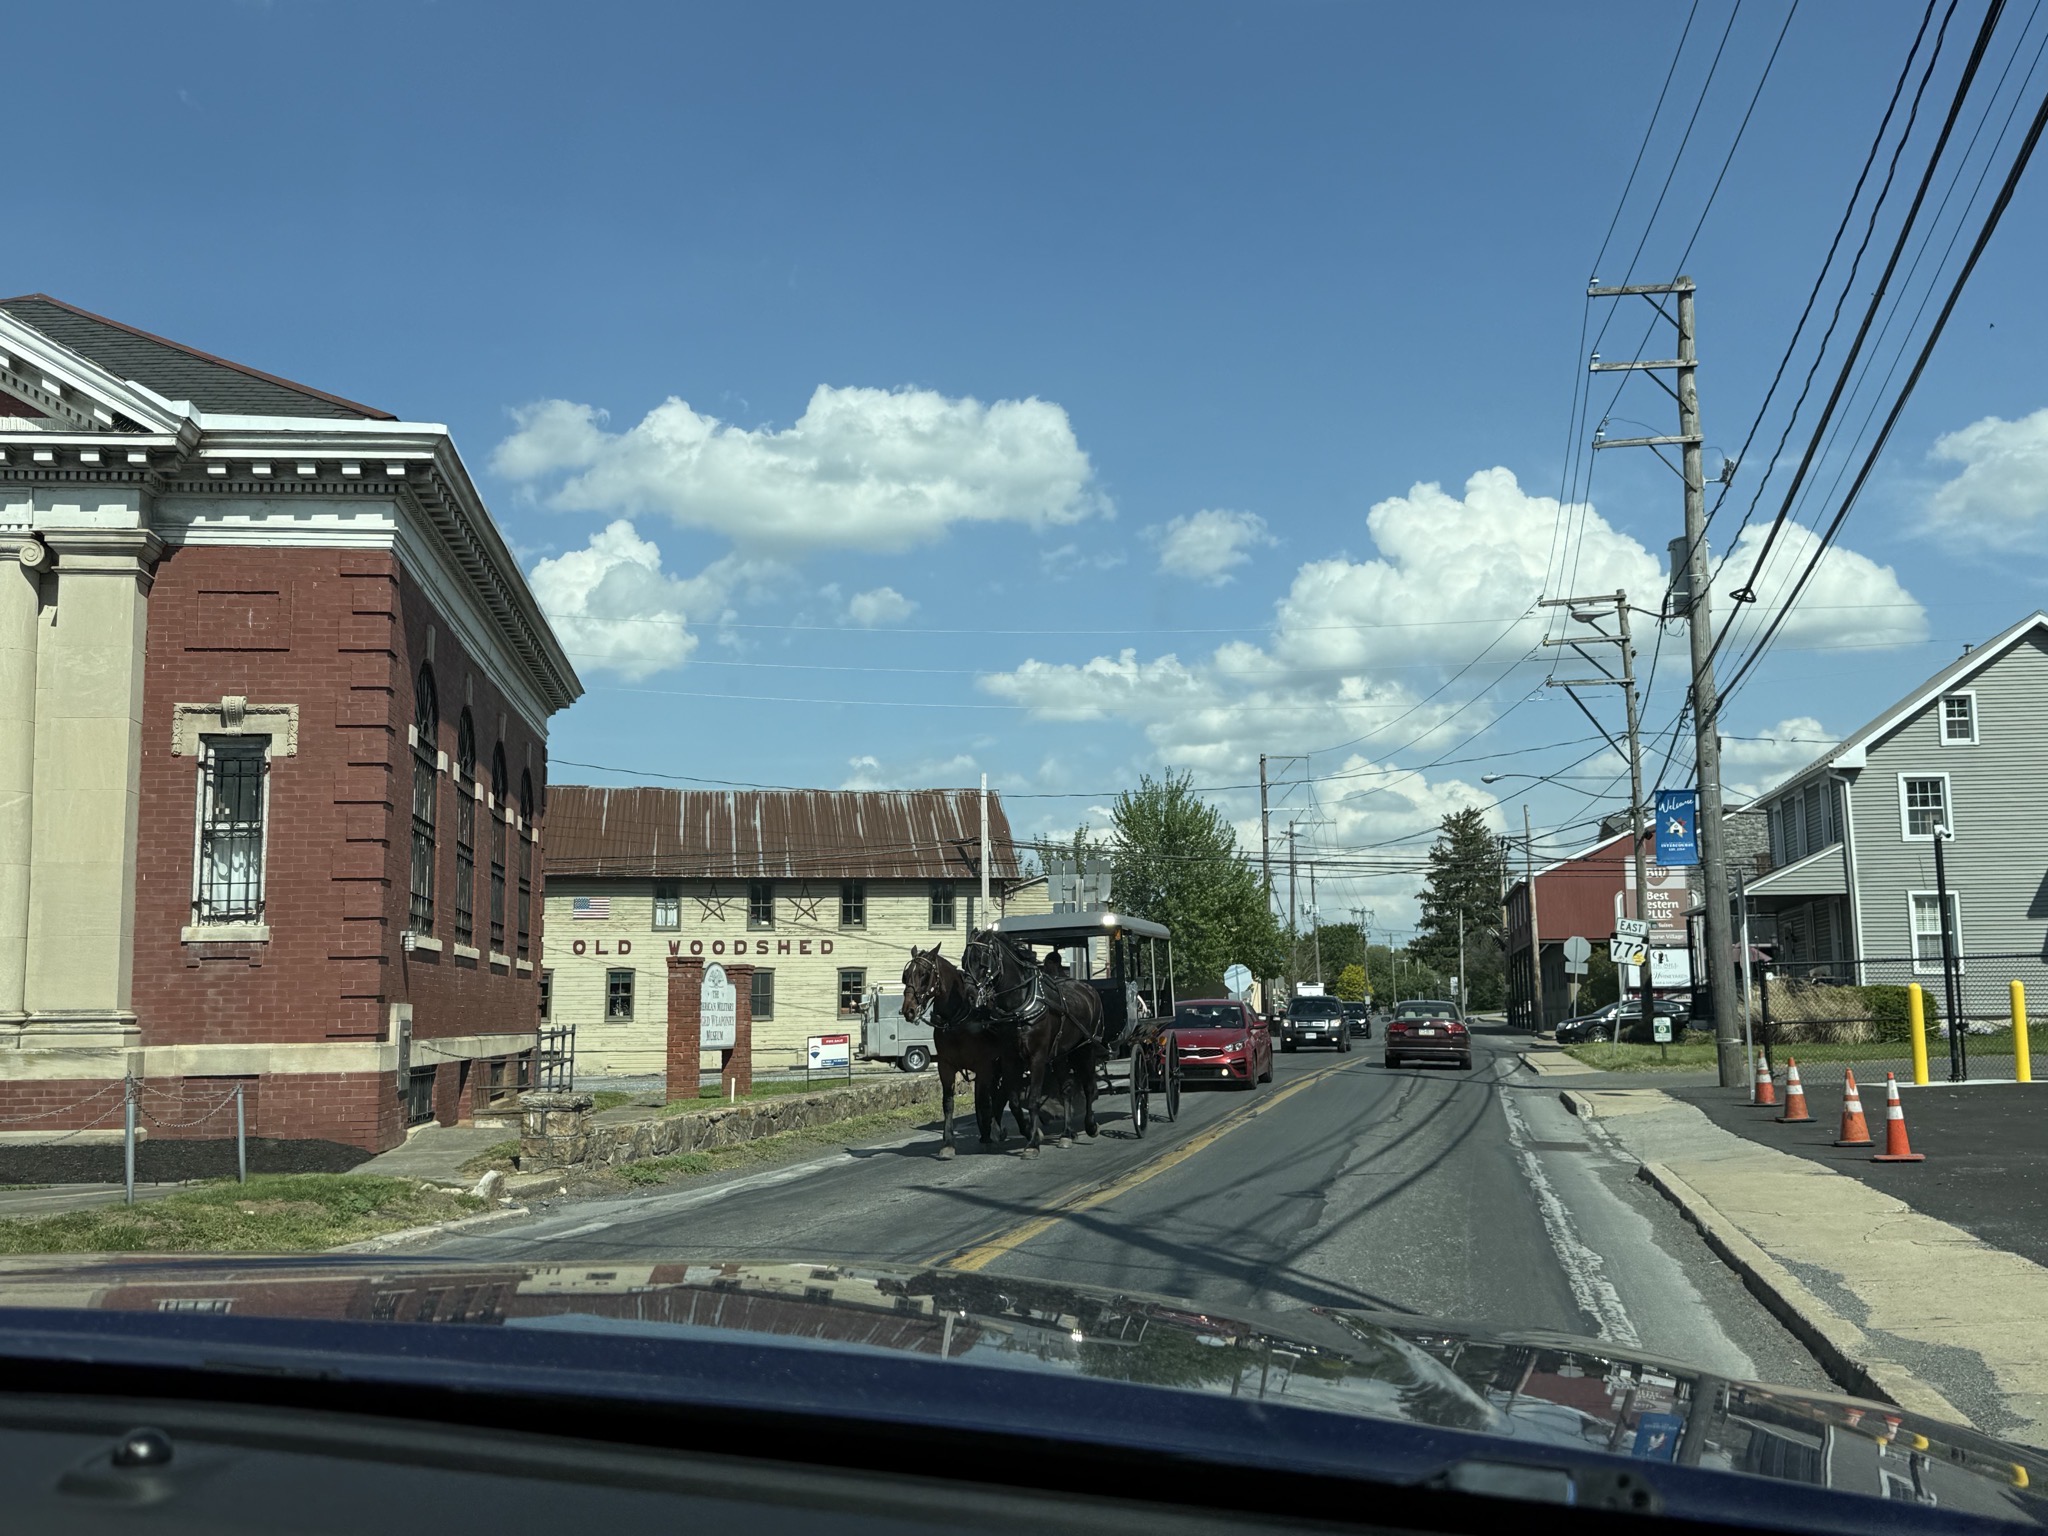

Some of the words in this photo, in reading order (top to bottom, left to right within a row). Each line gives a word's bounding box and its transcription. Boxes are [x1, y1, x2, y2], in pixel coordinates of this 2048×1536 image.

[1658, 797, 1694, 813] Welcome
[1646, 891, 1669, 901] Best
[1647, 901, 1679, 909] estern
[1620, 920, 1643, 933] EAST
[572, 939, 632, 955] OLD
[668, 939, 834, 956] WOODSHED
[1613, 940, 1644, 958] 772
[706, 1030, 723, 1041] MUSEUM
